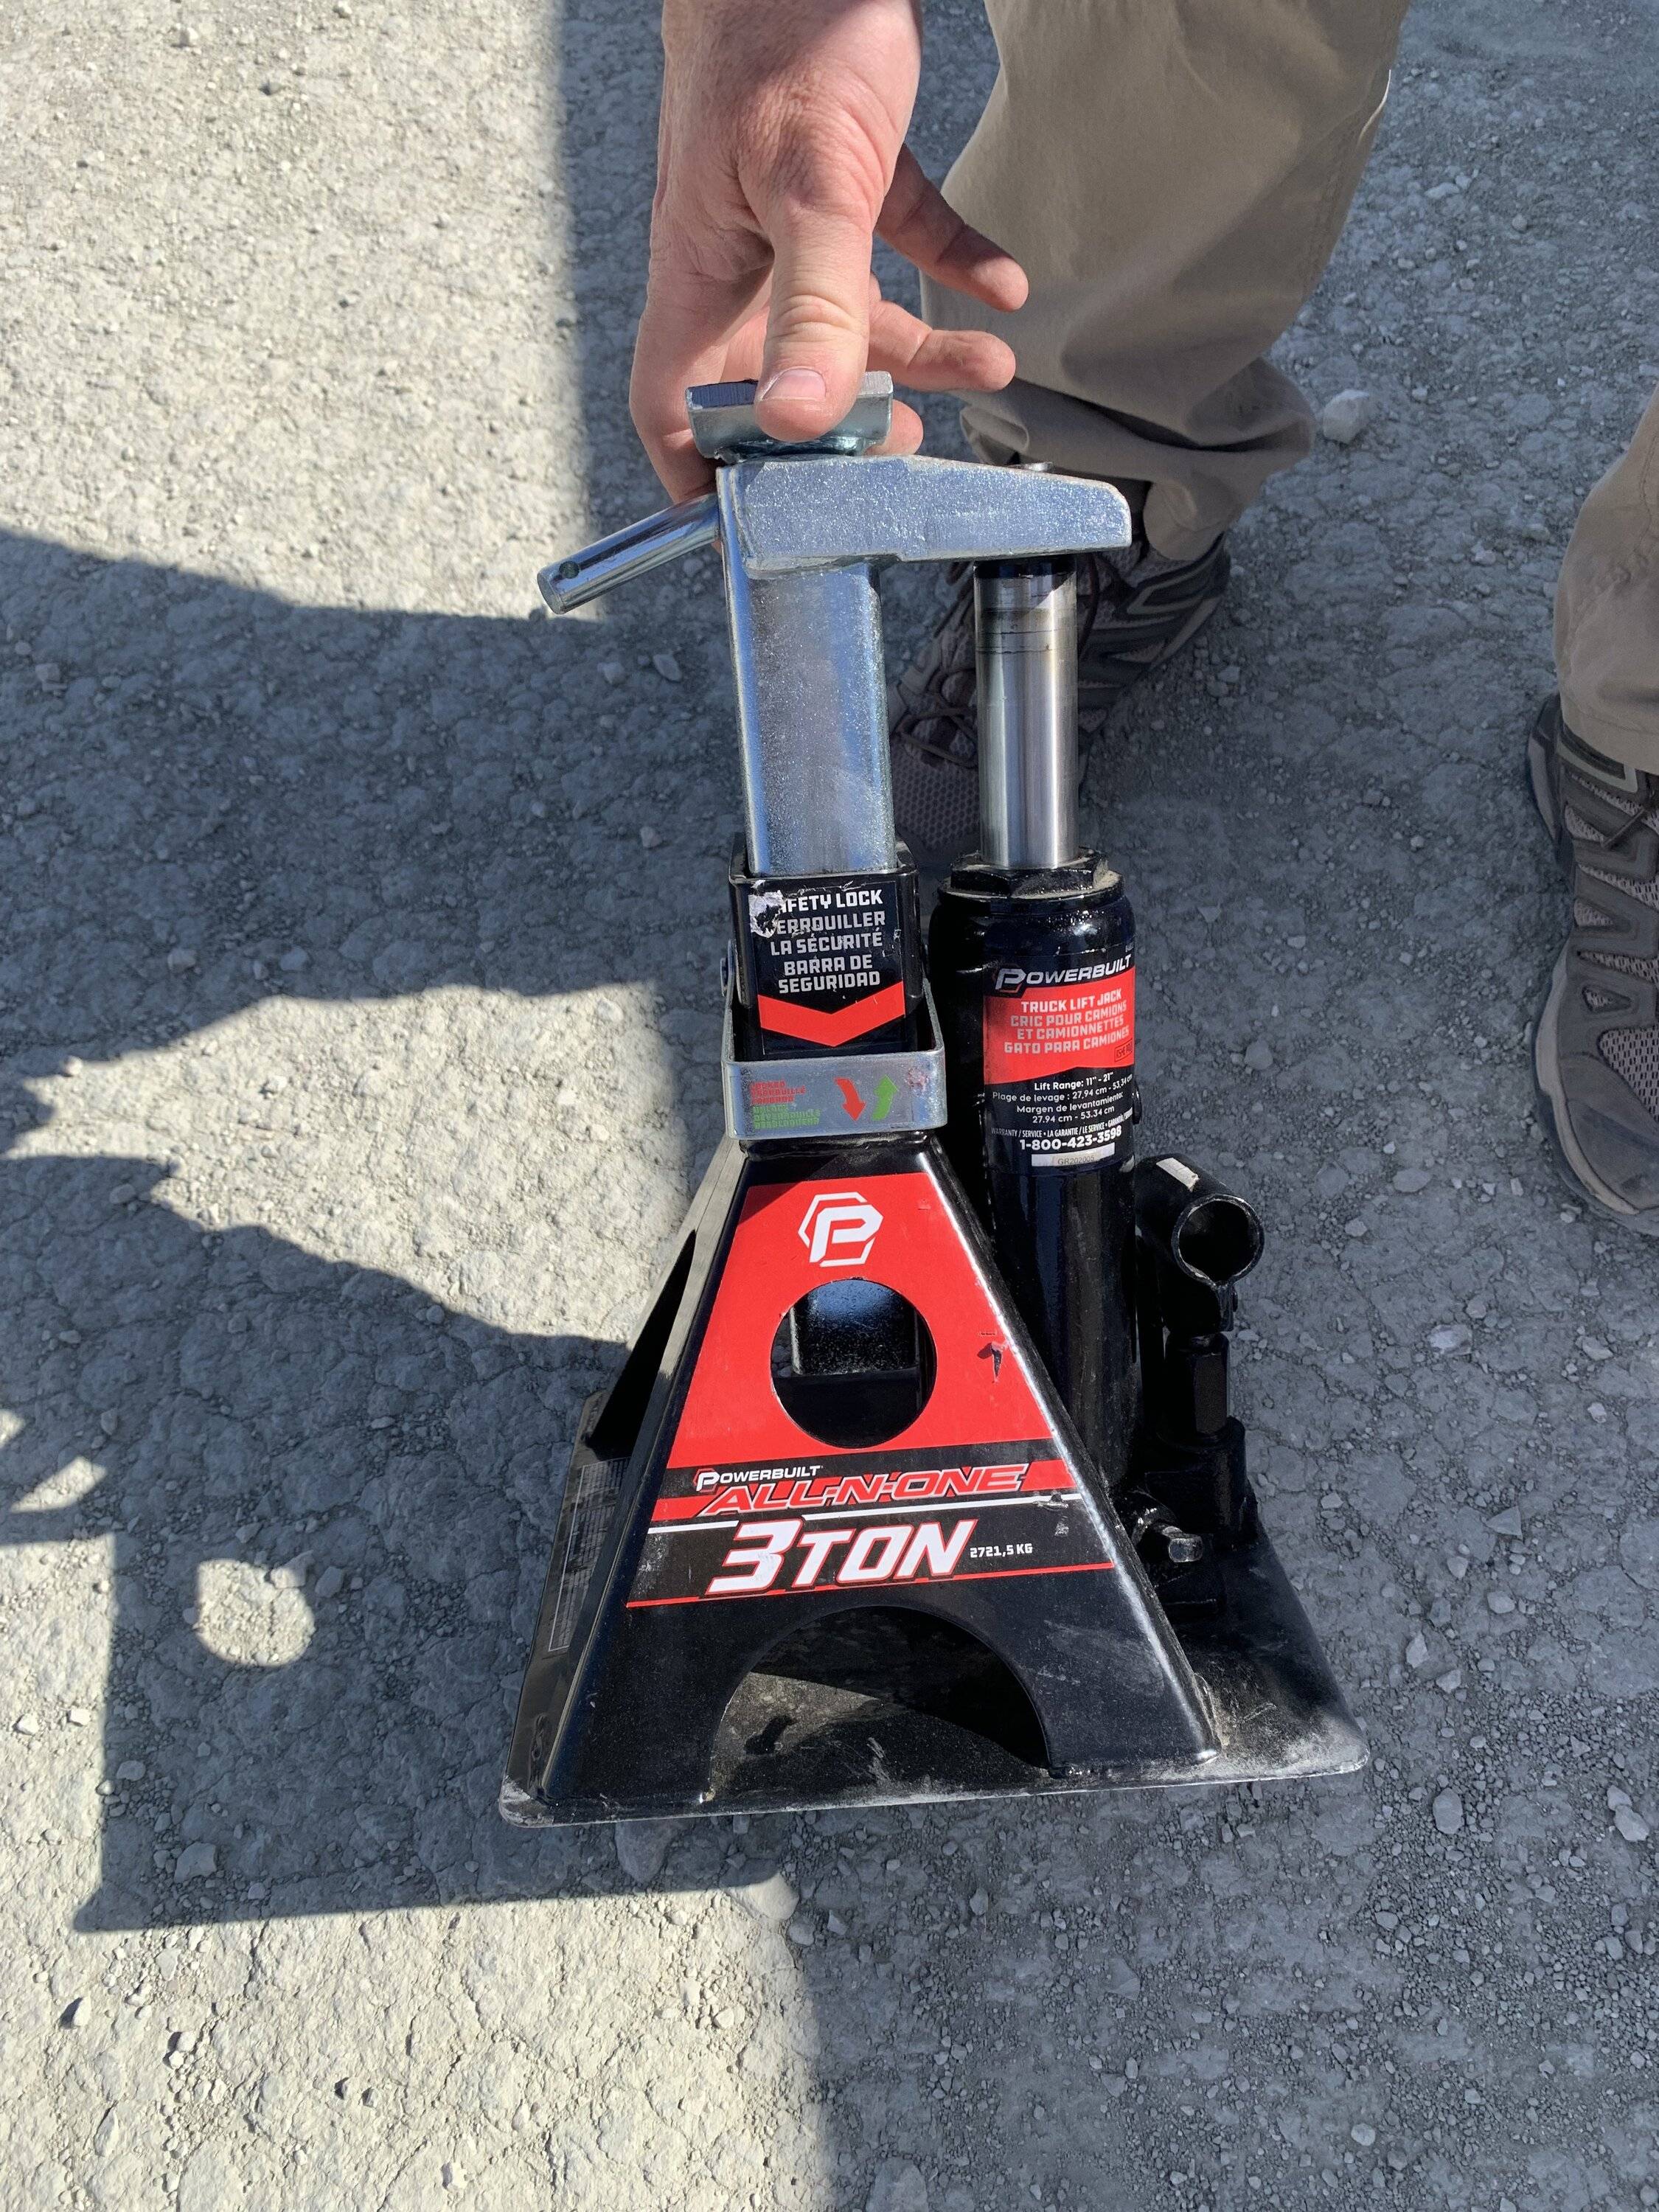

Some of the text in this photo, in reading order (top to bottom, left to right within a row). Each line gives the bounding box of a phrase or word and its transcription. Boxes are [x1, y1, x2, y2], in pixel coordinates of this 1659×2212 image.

[779, 889, 883, 914] FETY LOCK
[776, 911, 886, 934] ERROUILLER
[771, 928, 883, 956] LA SÉCURITÉ
[784, 954, 873, 976] BARRA DE
[995, 954, 1132, 990] POWERBUILT
[778, 970, 880, 993] SEGURIDAD
[1021, 988, 1121, 1013] TRUCK LIFT JACK
[1010, 1000, 1127, 1027] CRIC POUR CAMIONS
[1017, 1014, 1124, 1040] ET CAMIONNETTES
[1004, 1042, 1041, 1054] GATO
[1044, 1039, 1080, 1054] PARA
[1083, 1026, 1130, 1050] CAMIONES
[992, 1091, 1018, 1102] Plage
[1020, 1093, 1032, 1102] de
[1034, 1093, 1065, 1103] levage
[1095, 1087, 1107, 1095] cm
[1034, 1082, 1051, 1091] Lift
[1053, 1080, 1084, 1092] Range:
[1017, 1105, 1054, 1115] Margen
[1056, 1102, 1068, 1112] de
[1032, 1114, 1056, 1123] 27.94
[1058, 1115, 1073, 1123] cm
[1080, 1108, 1103, 1119] 53.34
[1104, 1105, 1115, 1115] cm
[1019, 1125, 1122, 1150] 1-800-423-3598
[1022, 1130, 1043, 1138] SERVICE
[1054, 1127, 1079, 1138] GARANTIE
[1082, 1126, 1088, 1134] LE
[1088, 1121, 1105, 1133] SERVICE
[695, 1465, 822, 1491] POWERBUILT
[969, 1543, 1033, 1558] 2721,5 KG
